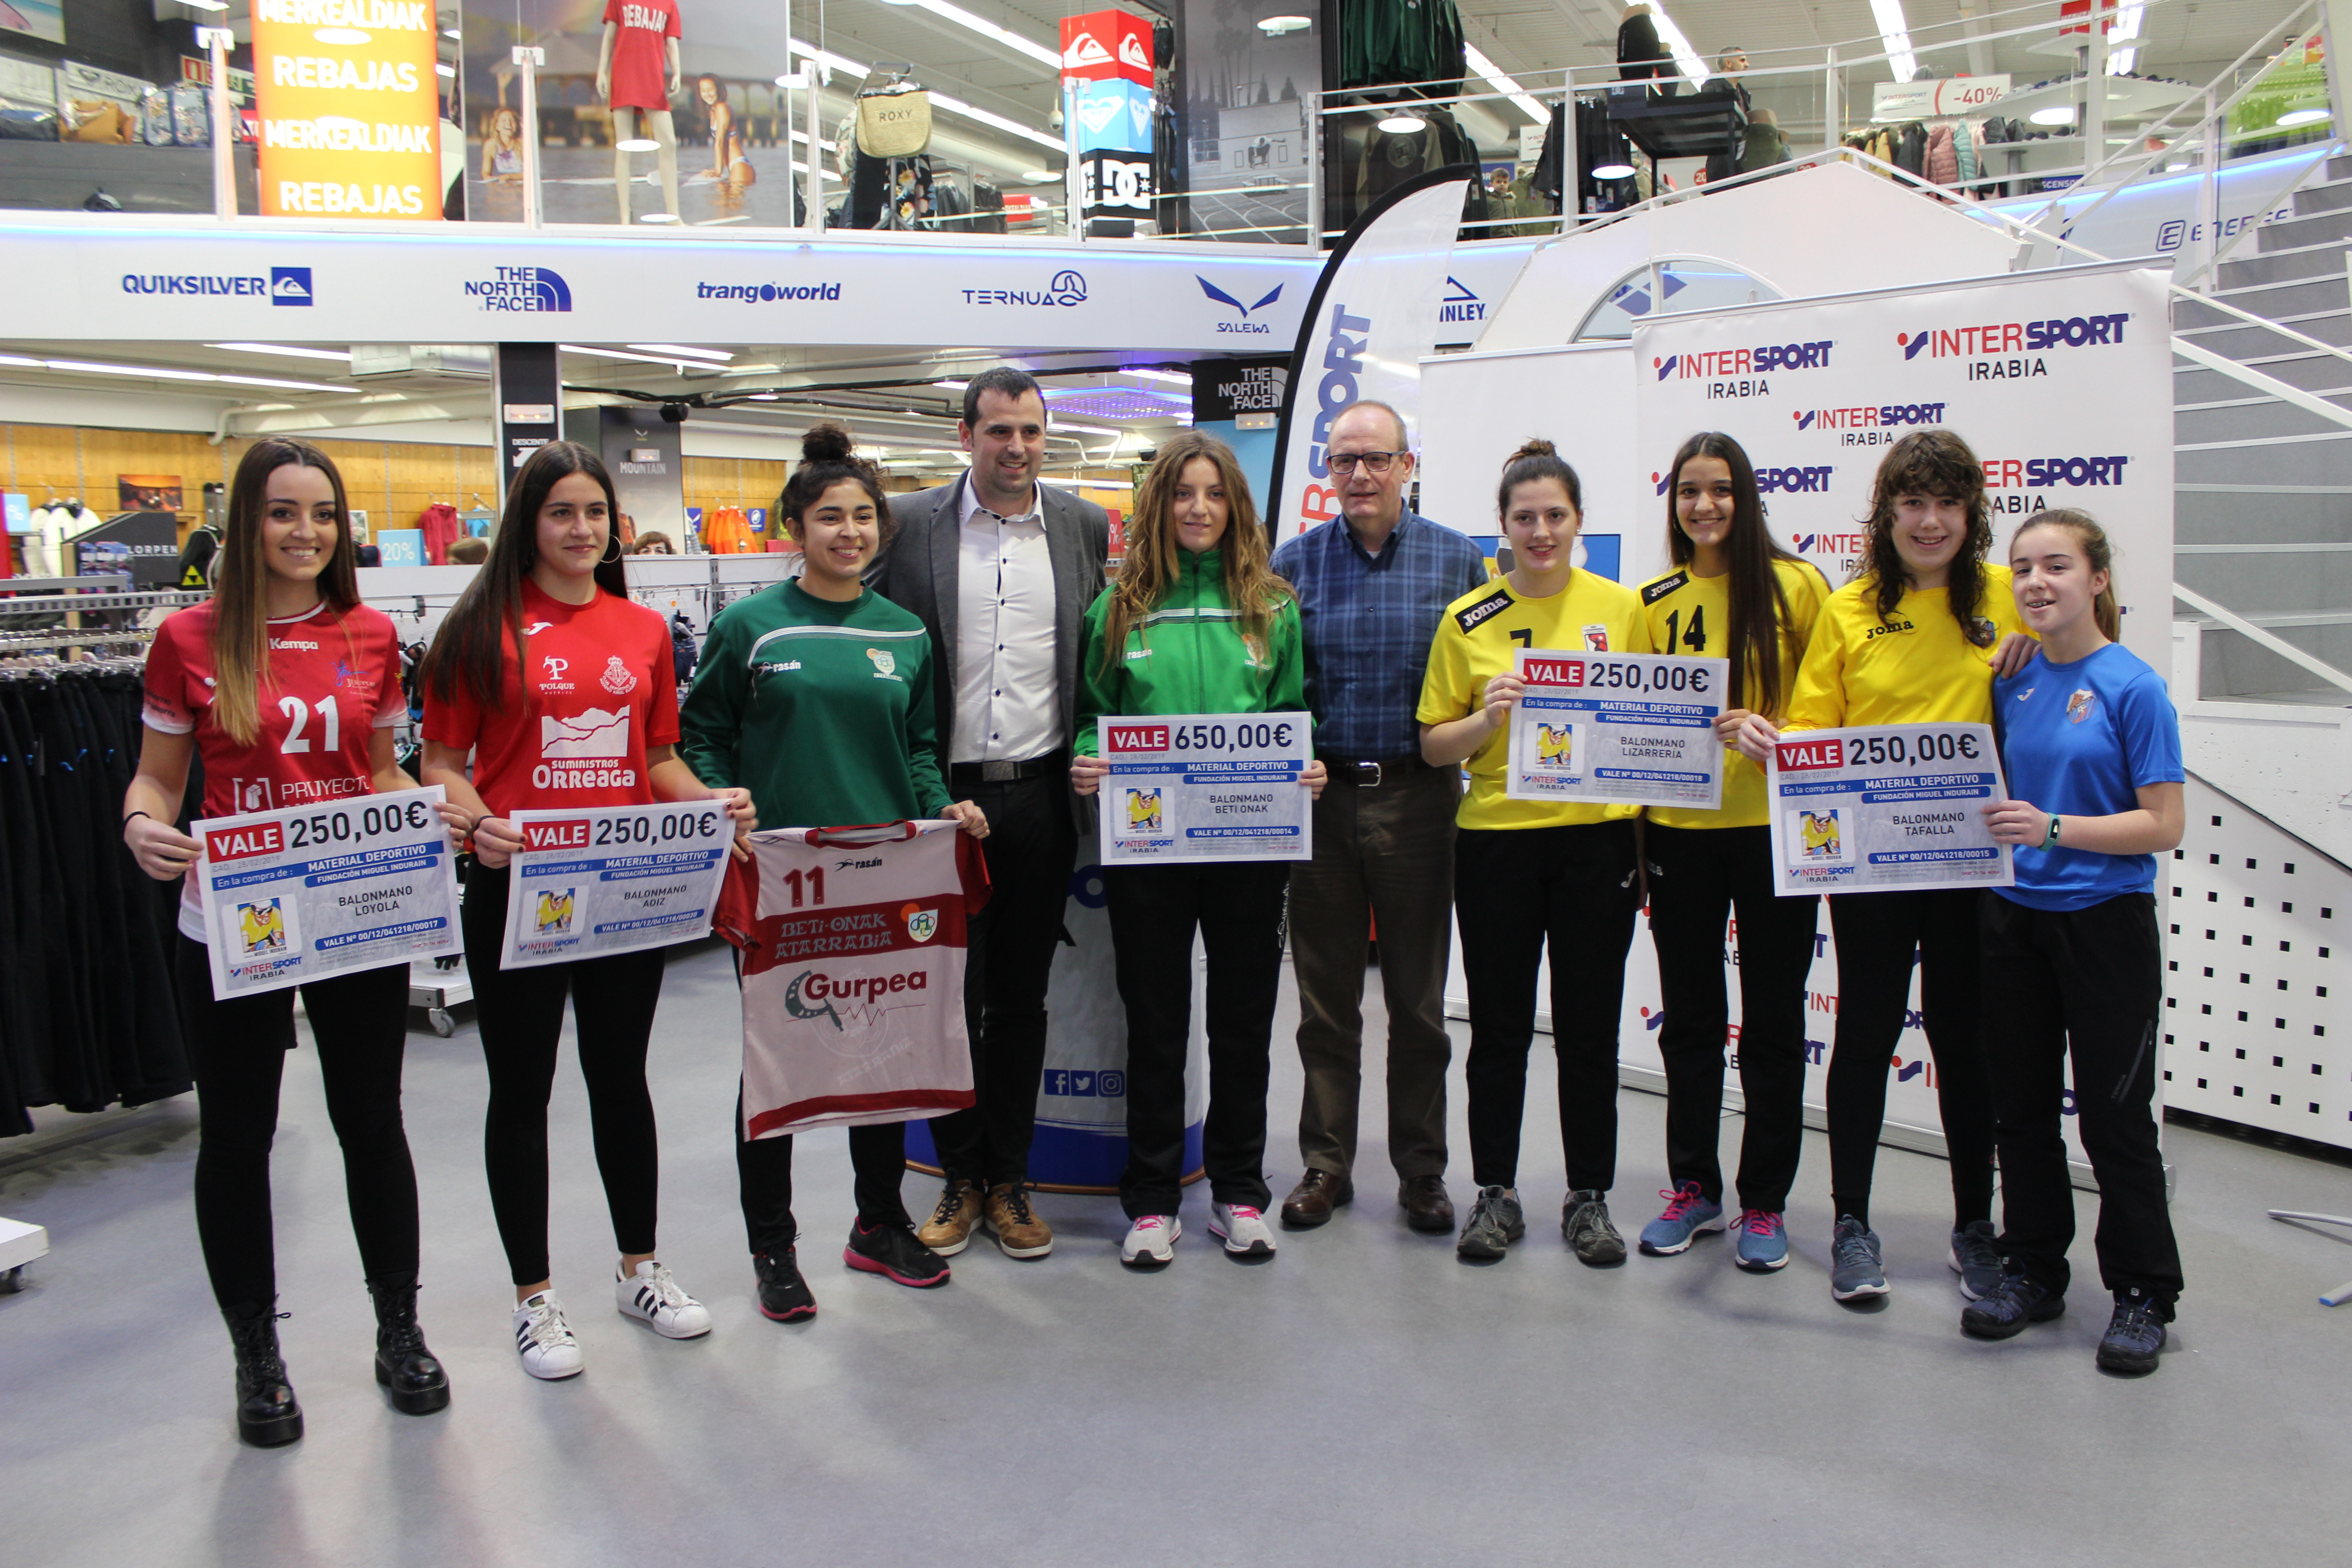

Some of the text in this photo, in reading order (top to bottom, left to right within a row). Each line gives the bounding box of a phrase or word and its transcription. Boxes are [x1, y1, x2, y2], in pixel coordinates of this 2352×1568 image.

[259, 0, 428, 32] MERKEALDIAK
[273, 56, 419, 92] REBAJAS
[1954, 86, 2002, 104] -40%
[878, 108, 913, 123] ROXY
[265, 118, 432, 154] MERKEALDIAK
[1102, 158, 1151, 210] DC
[280, 181, 423, 215] REBAJAS
[495, 266, 535, 281] THE
[122, 274, 267, 295] QUIKSILVER
[465, 282, 535, 296] NORTH
[697, 281, 841, 304] trangoworld
[962, 289, 1056, 306] TERNUA
[486, 297, 535, 311] FACE
[1216, 323, 1270, 333] SALEWA
[1932, 313, 2129, 358] INTERSPORT
[1679, 341, 1833, 379] INTERSPORT
[1241, 368, 1270, 382] THE
[1969, 358, 2047, 381] IRABIA
[1219, 381, 1270, 397] NORTH
[1708, 380, 1769, 399] IRABIA
[1234, 395, 1272, 409] FACE
[1816, 402, 1945, 430] INTERSPORT
[1841, 432, 1894, 446] IRABIA
[619, 462, 666, 474] MOUNTAIN
[127, 545, 178, 554] LORPEN
[382, 542, 415, 560] 20%
[1665, 604, 1706, 655] 14
[270, 638, 318, 652] Kempa
[773, 660, 801, 672] rasán
[1529, 662, 1709, 694] VALE 250,00€
[1546, 701, 1573, 710] compra
[1600, 701, 1703, 715] MATERIAL DEPORTIVO
[278, 695, 339, 755] 21
[1113, 723, 1292, 753] VALE 650,00€
[1621, 736, 1685, 748] BALONMANO
[1622, 746, 1682, 759] LIZARRERÍA
[1782, 733, 1980, 767] VALE 250,00€
[1132, 766, 1159, 774] compra
[1187, 762, 1289, 772] MATERIAL DEPORTIVO
[1193, 774, 1230, 783] FUNDACIÓN
[1532, 775, 1582, 784] INTERSPORT
[1632, 771, 1703, 782] 00/12/041218/00018
[1866, 774, 1979, 790] MATERIAL DEPORTIVO
[1804, 784, 1833, 794] compra
[1835, 783, 1846, 791] de
[1873, 792, 1915, 800] FUNDACIÓN
[1916, 790, 1943, 799] MIGUEL
[1210, 794, 1273, 804] BALONMANO
[1215, 804, 1268, 814] BETI ONAK
[1893, 813, 1965, 825] BALONMANO
[213, 801, 428, 857] VALE 250,00€
[529, 812, 718, 848] VALE 250,00€
[1905, 825, 1955, 836] TAFALLA
[308, 844, 426, 872] MATERIAL DEPORTIVO
[606, 851, 709, 868] MATERIAL DEPORTIVO
[855, 857, 882, 869] rasán
[1910, 850, 1989, 861] 00/12/041218/00015
[317, 858, 426, 883] FUNDACIÓN MIGUEL INDURAIN
[547, 863, 576, 875] compra
[611, 862, 705, 879] FUNDACIÓN MIGUEL INDURAIN
[1800, 867, 1855, 876] INTERSPORT
[218, 869, 288, 888] En la compra de
[624, 885, 687, 900] BALONMANO
[782, 865, 824, 908] 11
[338, 886, 412, 906] BALONMANO
[642, 897, 665, 907] AOIZ
[355, 900, 400, 916] LOYOLA
[602, 924, 619, 932] VALE
[631, 911, 698, 928] 00/12/041218/00020
[323, 936, 345, 948] VALE
[358, 920, 438, 941] 00/12/041218/00017
[528, 938, 580, 951] INTERSPORT
[533, 946, 563, 956] IRABIA
[242, 956, 302, 975] INTERSPORT
[249, 970, 285, 981] IRABIA
[804, 971, 927, 1004] Gurpea
